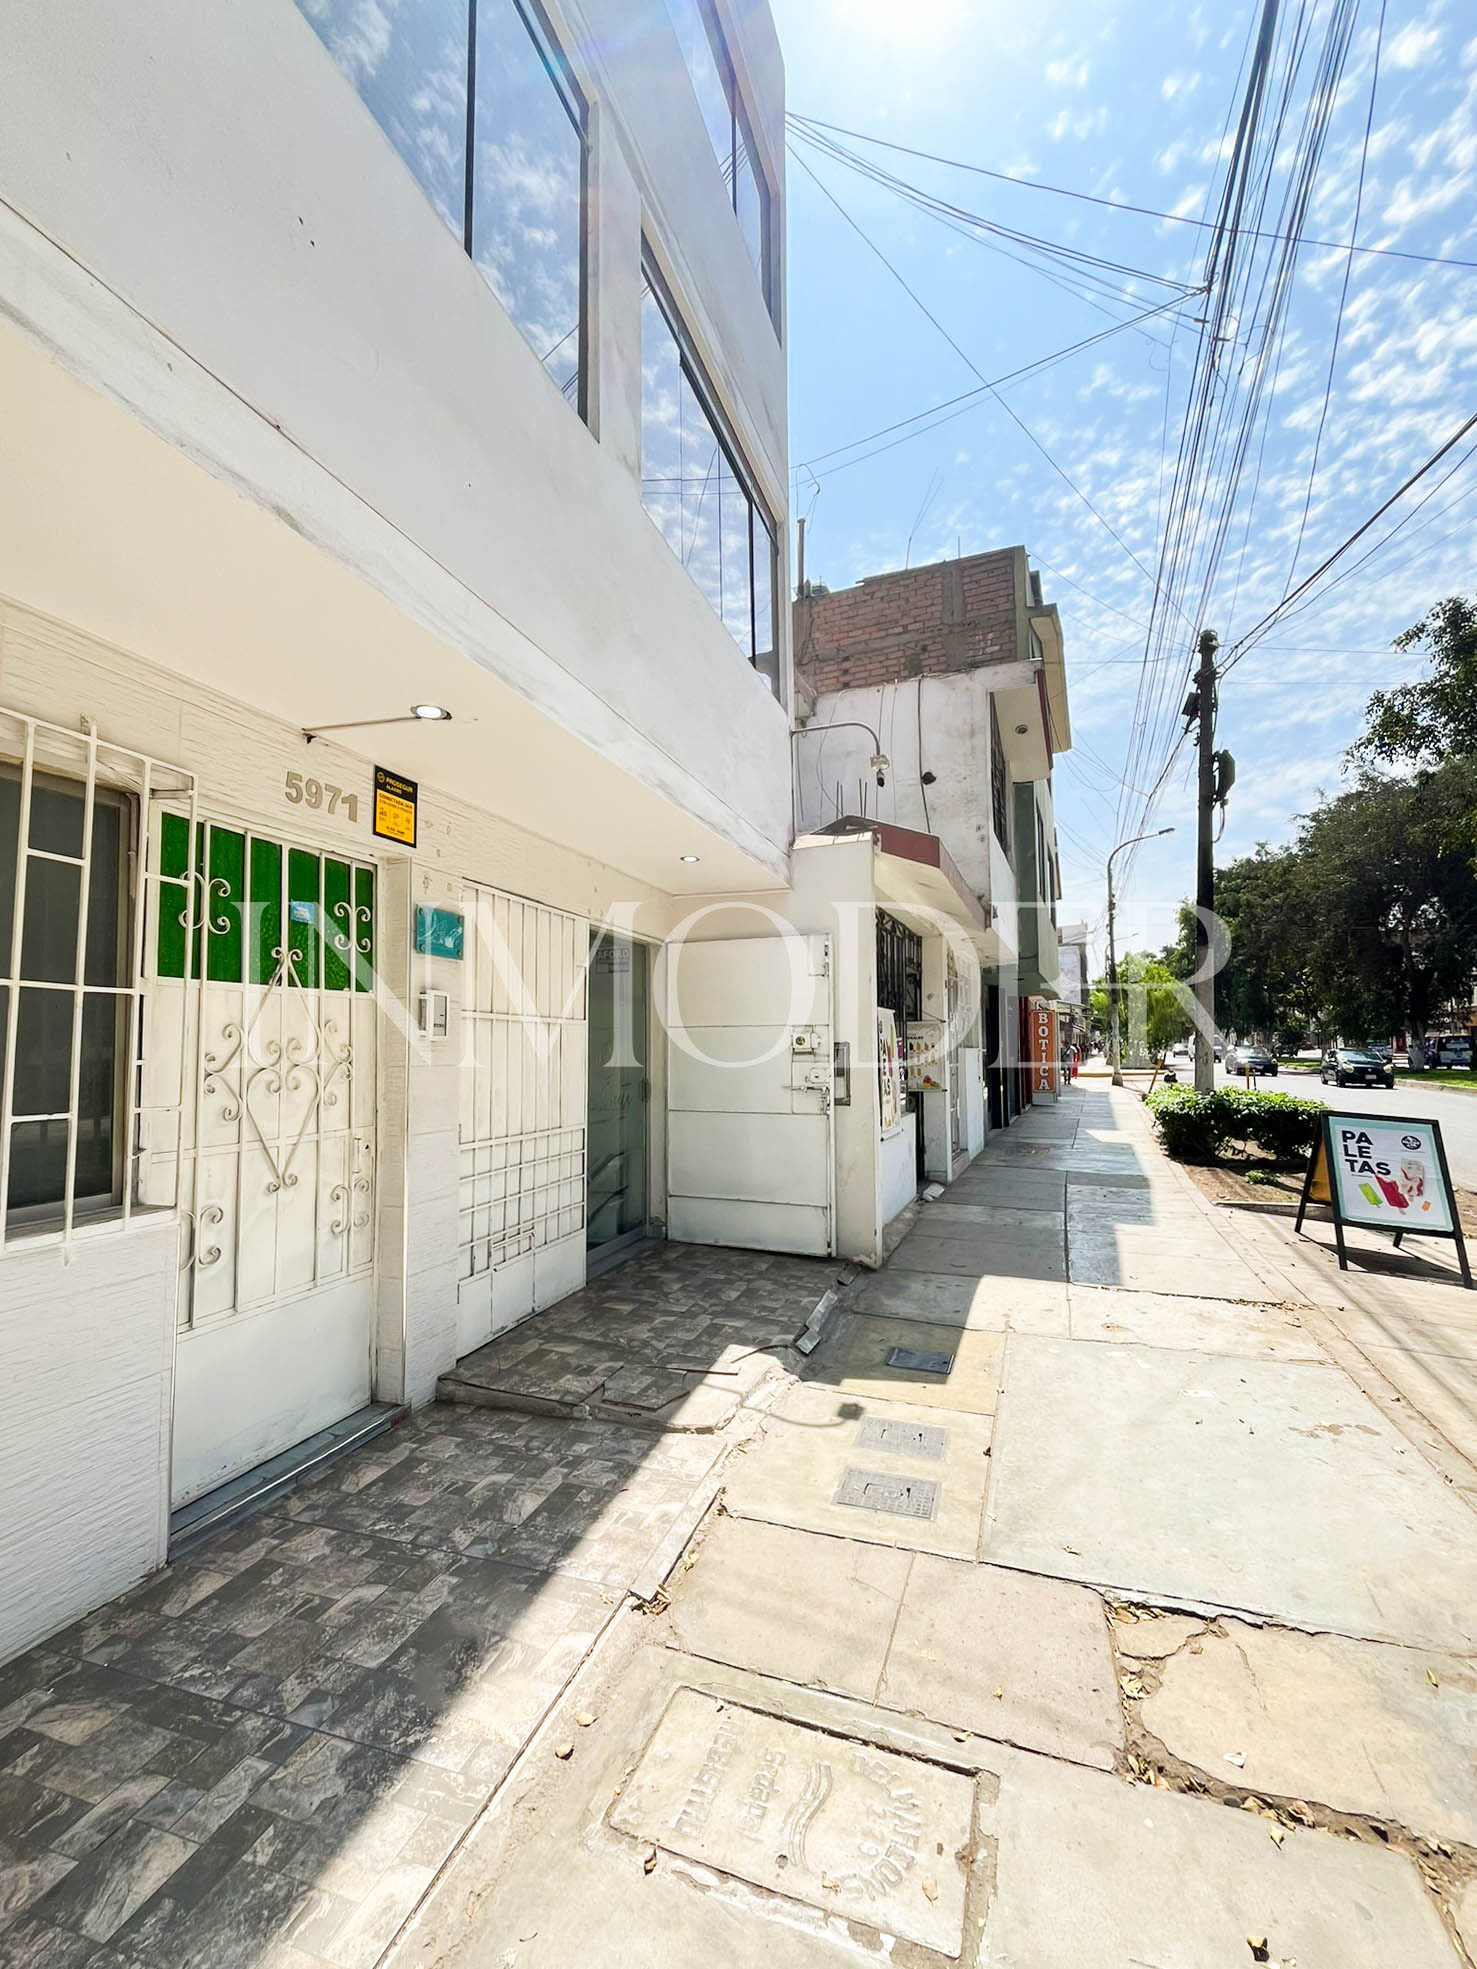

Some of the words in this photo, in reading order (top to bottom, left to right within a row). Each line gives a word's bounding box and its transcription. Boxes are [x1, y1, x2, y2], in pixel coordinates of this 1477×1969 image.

[285, 771, 359, 823] 5971
[1038, 1012, 1050, 1090] BOTICA
[1341, 1130, 1373, 1146] PA
[1343, 1144, 1372, 1159] LE
[1345, 1158, 1391, 1176] TAS
